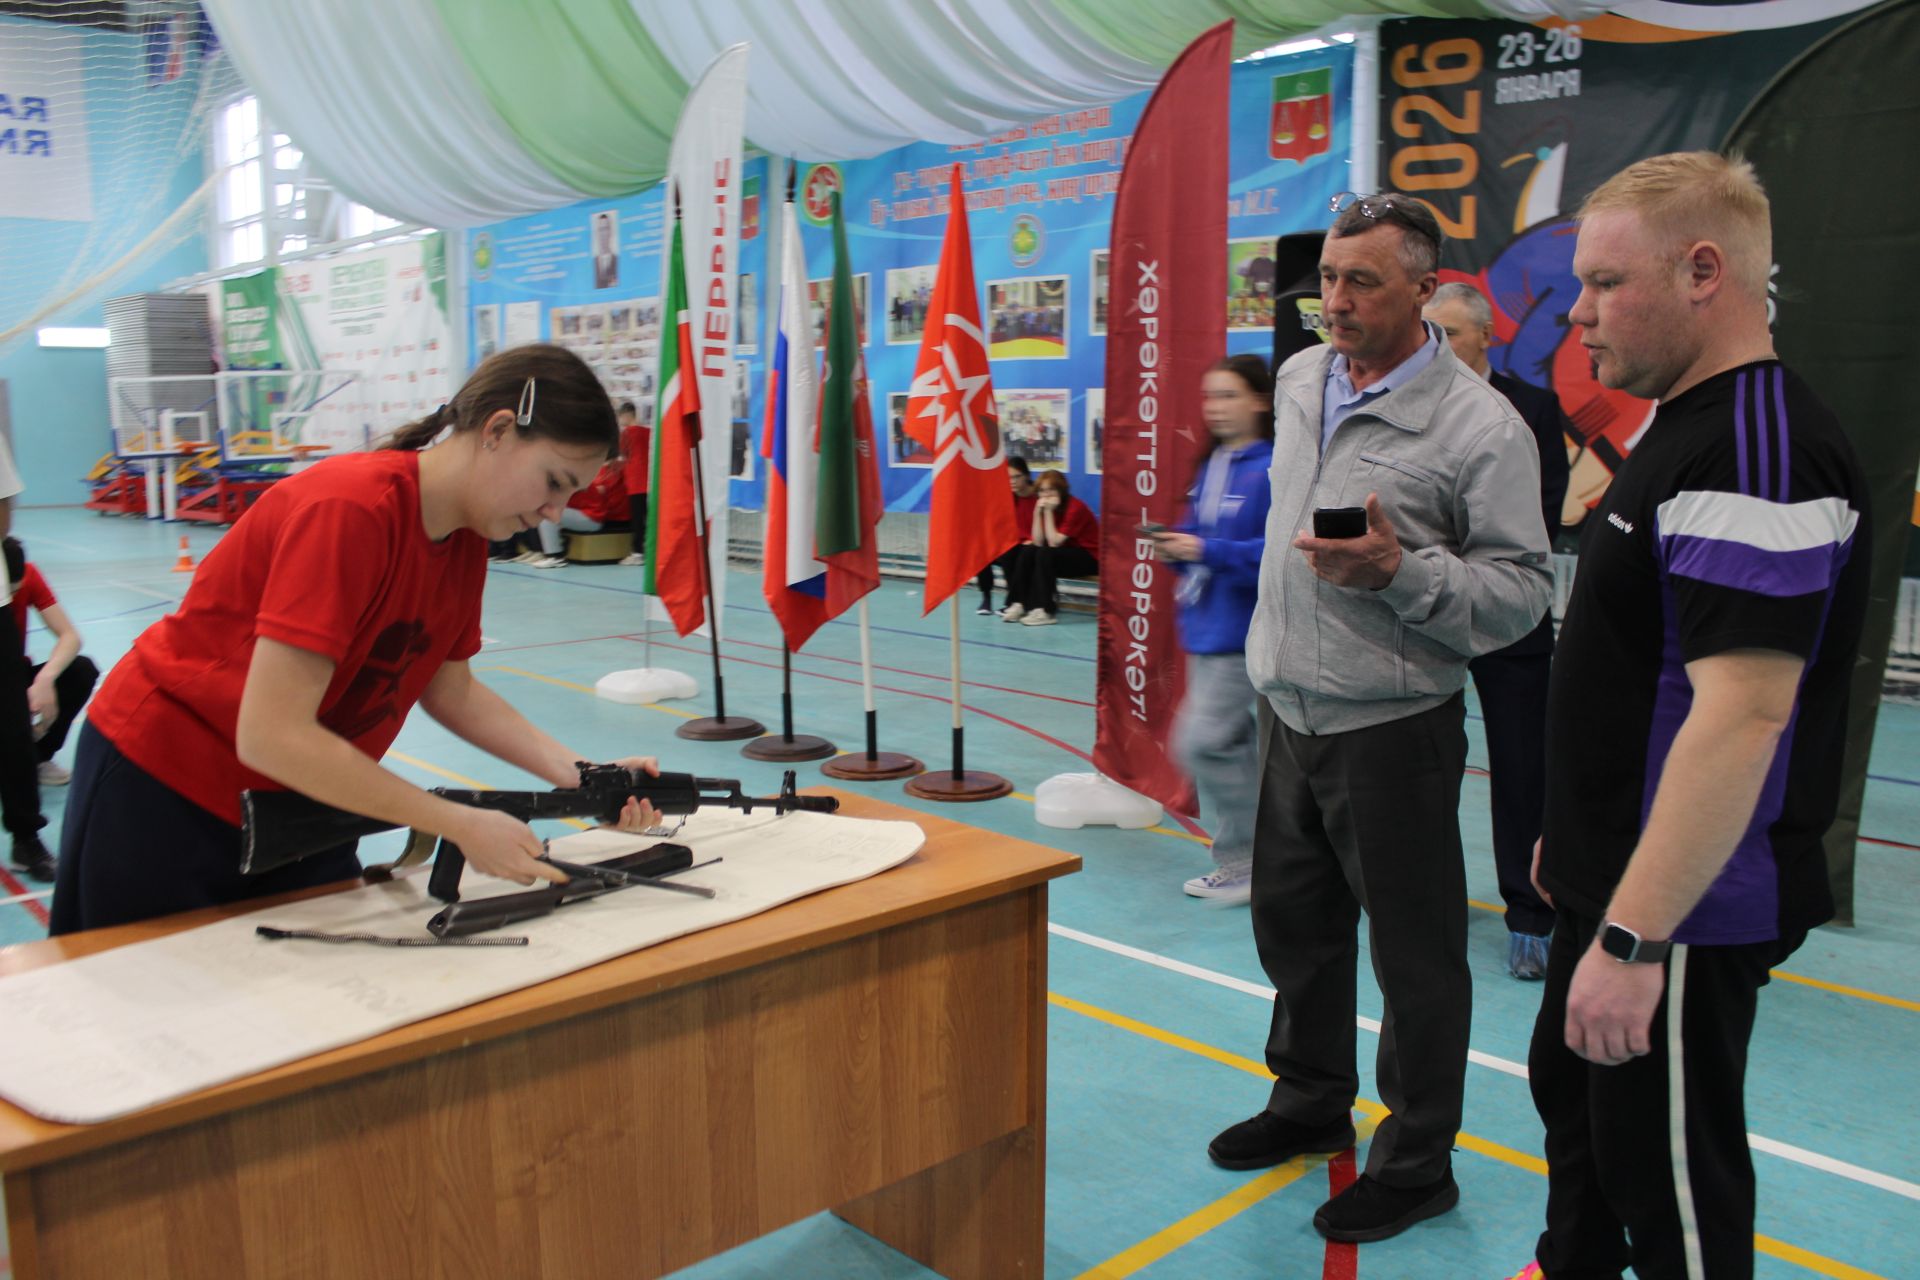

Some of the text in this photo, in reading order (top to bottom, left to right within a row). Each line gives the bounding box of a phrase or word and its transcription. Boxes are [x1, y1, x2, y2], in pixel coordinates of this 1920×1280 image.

[1497, 25, 1582, 68] 23-26
[1495, 69, 1581, 104] ЯНВАРЯ
[1390, 38, 1484, 239] 2026
